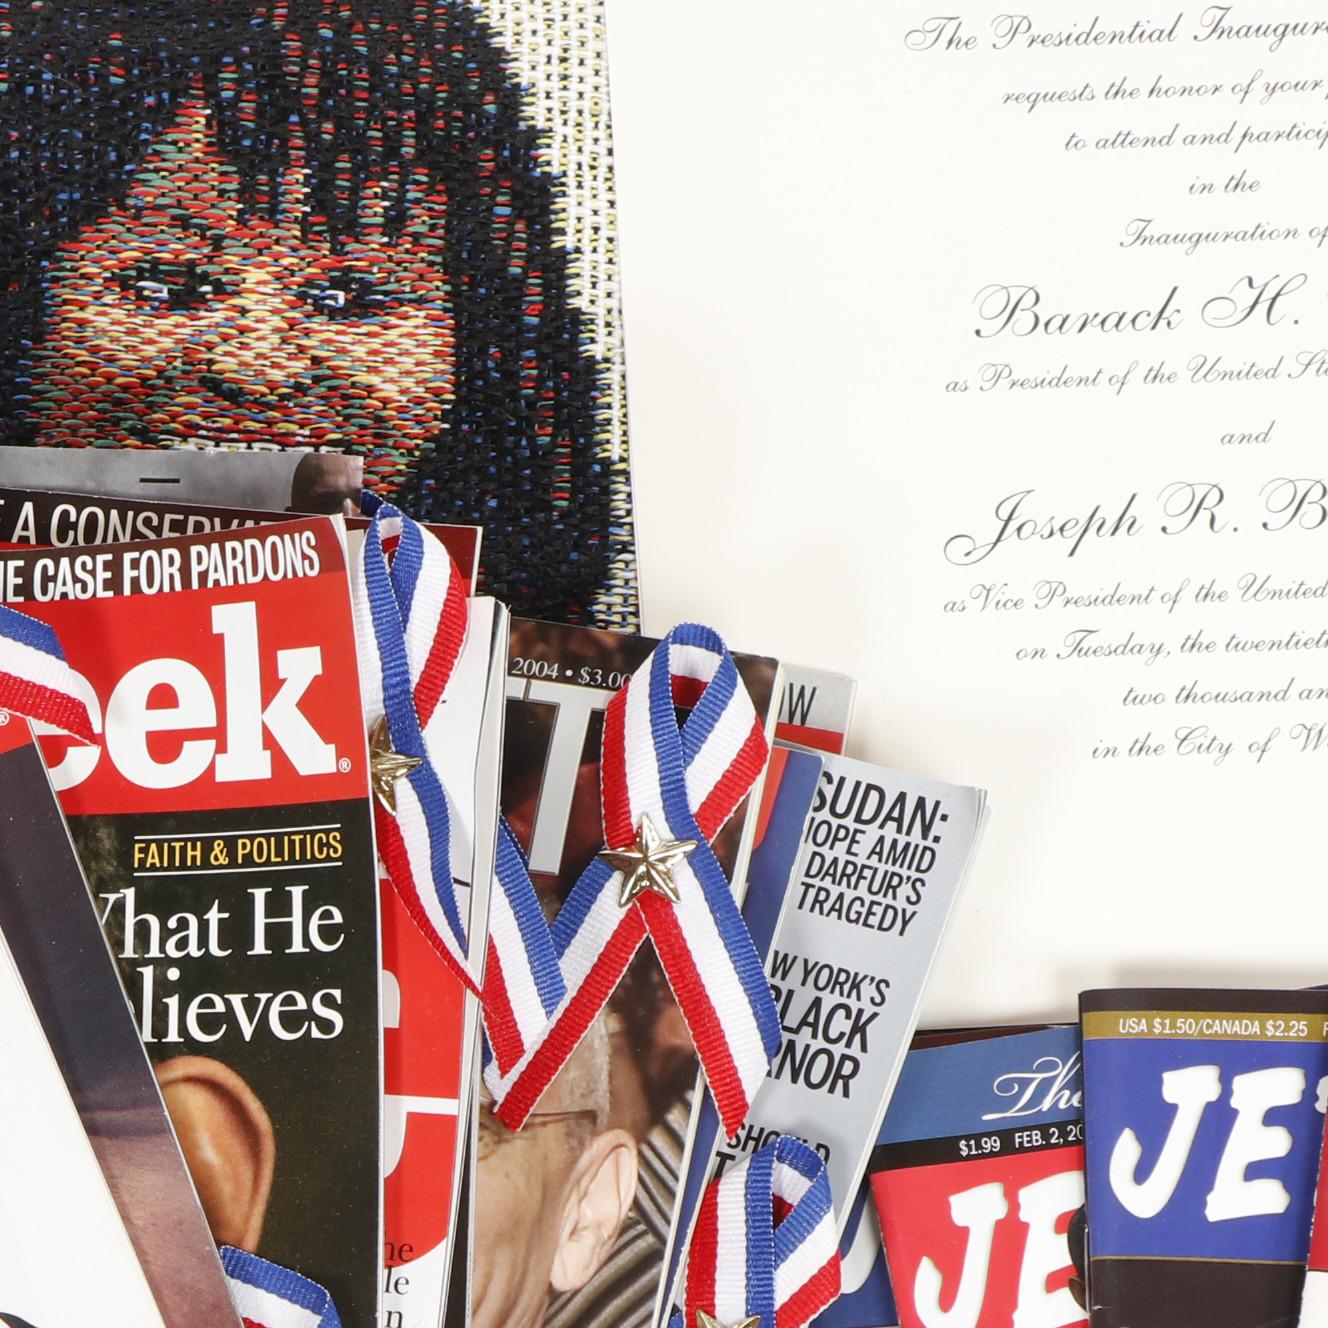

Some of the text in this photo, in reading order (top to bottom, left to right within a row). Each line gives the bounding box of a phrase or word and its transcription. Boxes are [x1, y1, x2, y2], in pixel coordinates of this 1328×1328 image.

[903, 15, 978, 52] The
[990, 12, 1184, 50] Presidential
[1002, 80, 1097, 114] requests
[1104, 76, 1141, 101] the
[1147, 74, 1224, 98] honor
[1230, 69, 1264, 105] of
[1262, 77, 1324, 105] your
[1065, 121, 1238, 152] to attend and
[1188, 169, 1261, 196] in the
[1119, 218, 1299, 256] Inauguration
[972, 273, 1308, 339] Barack H.
[945, 353, 1285, 396] as President of the United
[1220, 420, 1276, 445] and
[12, 502, 35, 544] A
[944, 481, 1239, 566] Joseph R.
[34, 530, 320, 602] CASE FOR PARDONS
[943, 572, 1328, 614] as Vice President of the United
[511, 657, 559, 678] 2004
[1015, 629, 1217, 667] on Tuesday, the
[1123, 677, 1296, 707] two thousand
[1092, 725, 1281, 766] in the City of
[812, 771, 949, 844] SUDAN:
[133, 831, 343, 868] FAITH & POLITICS
[866, 835, 936, 875] AMID
[804, 851, 926, 907] DARFUR'S
[247, 885, 345, 956] He
[797, 881, 918, 937] TRAGEDY
[134, 964, 344, 1043] lieves
[800, 958, 891, 1008] YORK'S
[1118, 1018, 1147, 1034] USA
[1153, 1018, 1261, 1036] $1.50/CANADA
[1265, 1019, 1308, 1037] $2.25
[959, 1127, 1064, 1158] $1.99 FEB. 2,
